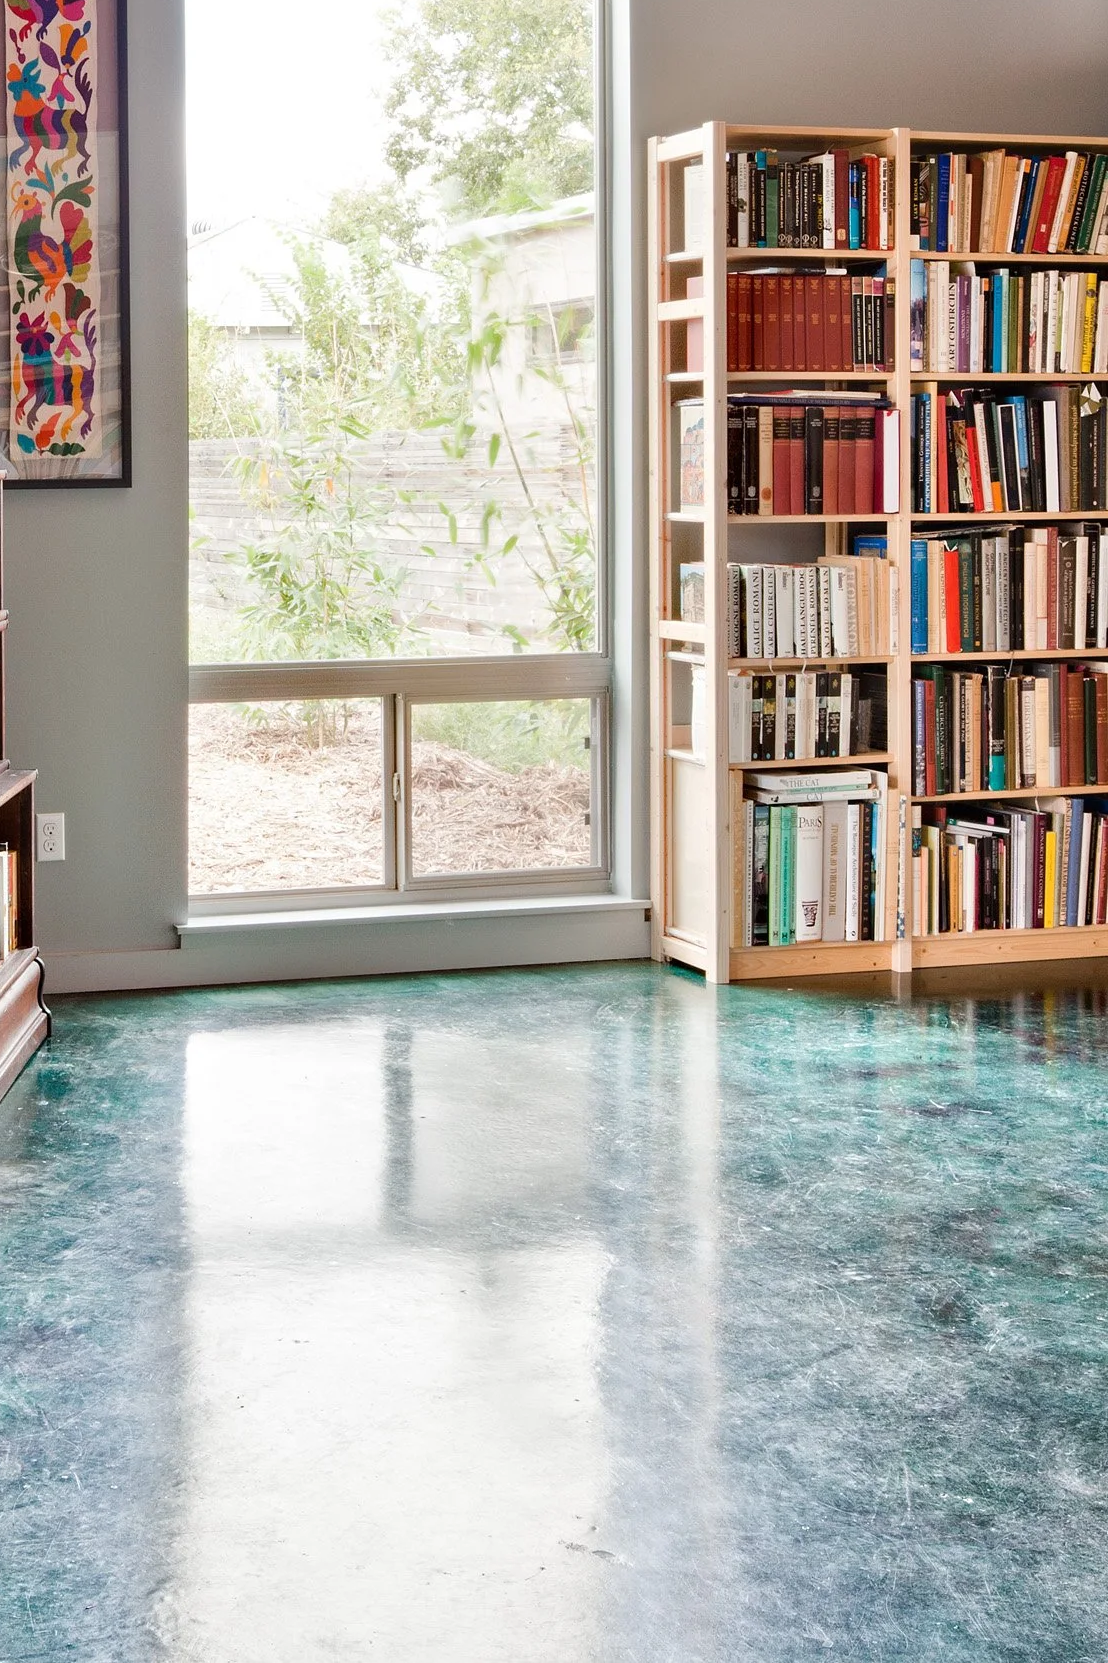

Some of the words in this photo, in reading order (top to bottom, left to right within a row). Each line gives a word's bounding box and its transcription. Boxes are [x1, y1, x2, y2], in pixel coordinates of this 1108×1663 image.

[1077, 171, 1089, 205] GOTISCHE
[1069, 207, 1082, 245] BAUKUNST
[1024, 696, 1032, 742] CHRISTIAN
[1024, 744, 1032, 759] ART
[788, 780, 804, 788] THE
[806, 793, 824, 801] CAT
[1063, 848, 1069, 857] DE
[830, 858, 838, 866] OF
[829, 868, 837, 902] CATHEDRAL
